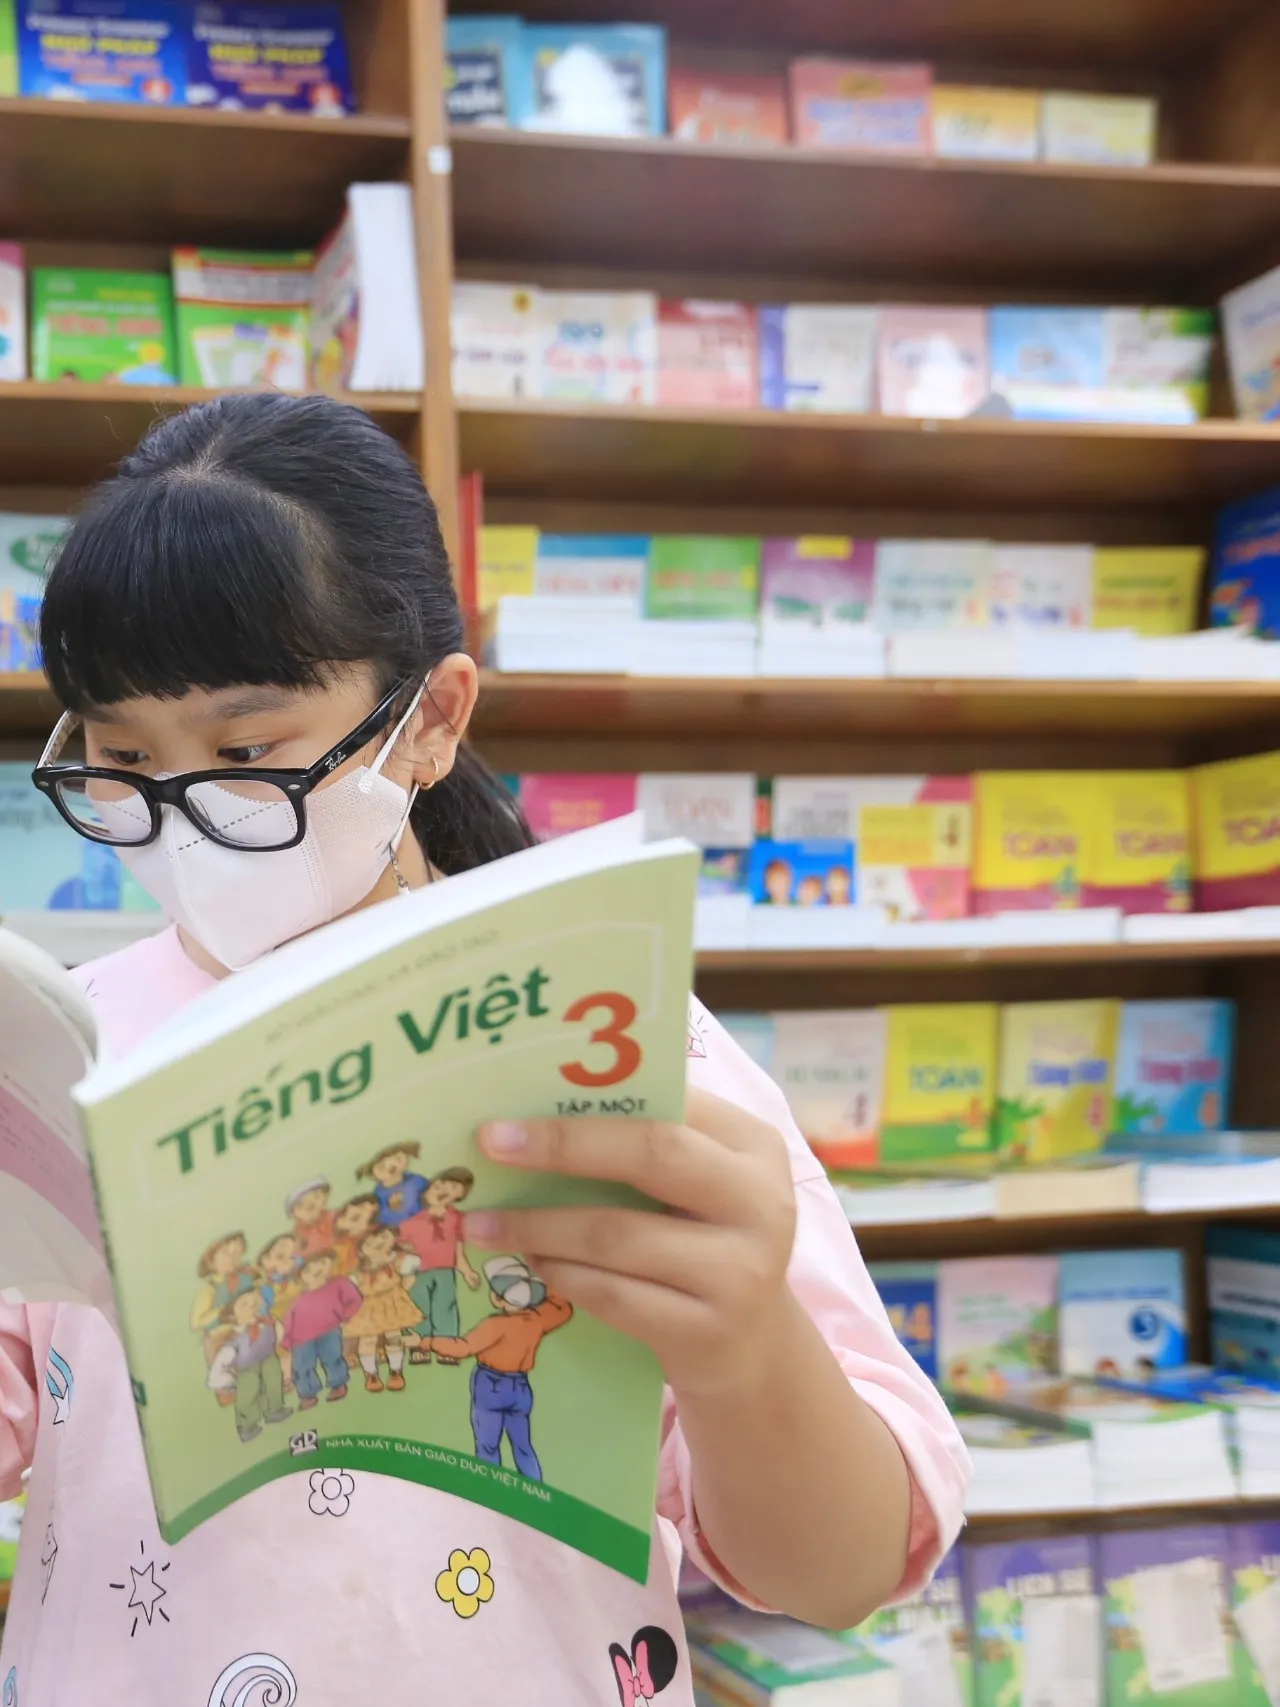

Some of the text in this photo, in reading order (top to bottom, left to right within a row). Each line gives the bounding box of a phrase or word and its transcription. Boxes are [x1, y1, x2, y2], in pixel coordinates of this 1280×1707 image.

[156, 1040, 374, 1176] Tiếng
[396, 964, 552, 1055] Việt
[558, 989, 643, 1088] 3
[555, 1095, 647, 1117] TẬP MỘT
[325, 1435, 553, 1504] NHÀ XUẤT BẢN GIÁO DỤC VIỆT NAM
